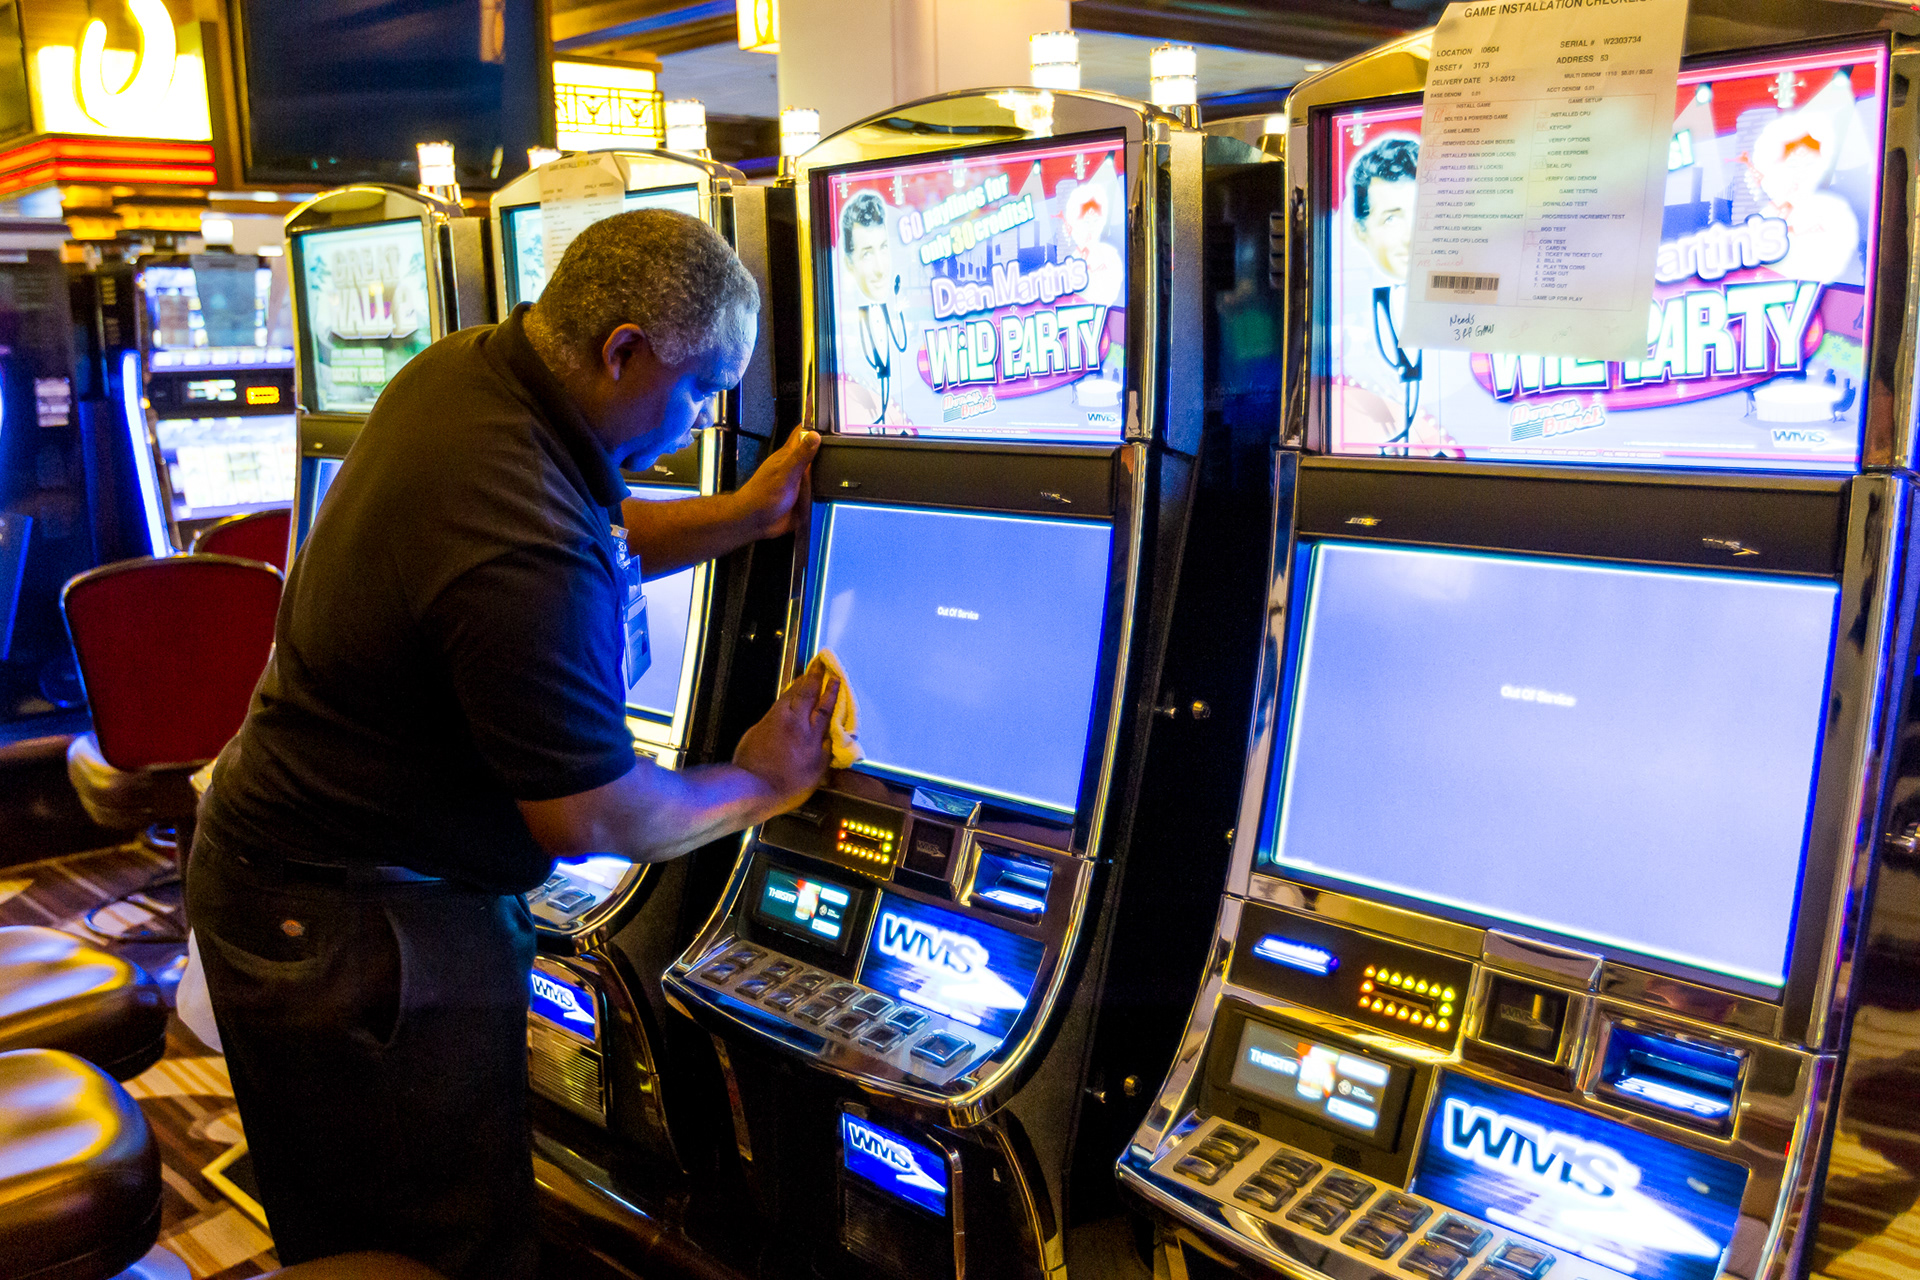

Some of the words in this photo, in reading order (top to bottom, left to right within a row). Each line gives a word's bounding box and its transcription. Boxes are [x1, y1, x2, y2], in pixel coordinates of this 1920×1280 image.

[1464, 5, 1496, 18] GAME
[1499, 0, 1582, 15] INSTALLATION
[1436, 48, 1473, 57] LOCATION
[1560, 40, 1588, 49] SERIAL
[1603, 35, 1642, 45] W2303734
[1434, 63, 1457, 72] ASSET
[1473, 61, 1490, 70] 3173
[1556, 54, 1594, 64] ADDRESS
[1600, 54, 1609, 62] 53
[1432, 77, 1462, 86] DELIVERY
[1463, 76, 1481, 84] DATE
[1489, 75, 1515, 83] 3-1-2012
[899, 211, 924, 245] 60
[923, 186, 986, 234] paylines
[983, 172, 1009, 204] for
[920, 233, 952, 265] only
[950, 220, 976, 255] 30
[973, 193, 1035, 242] credits!
[1656, 214, 1790, 283] artin's
[931, 276, 996, 320] Dean
[991, 255, 1089, 307] Martin's
[1000, 303, 1108, 382] PARTY
[1086, 412, 1116, 423] WMS
[1771, 429, 1826, 444] WMS
[937, 606, 949, 617] Out
[949, 608, 958, 618] Of
[957, 609, 980, 621] Service
[1500, 684, 1521, 699] Out
[1521, 687, 1537, 701] Of
[1536, 690, 1576, 708] Service
[882, 914, 987, 975] WMS
[532, 975, 575, 1008] WMS
[848, 1122, 913, 1172] WMS
[1446, 1099, 1638, 1198] WMS
